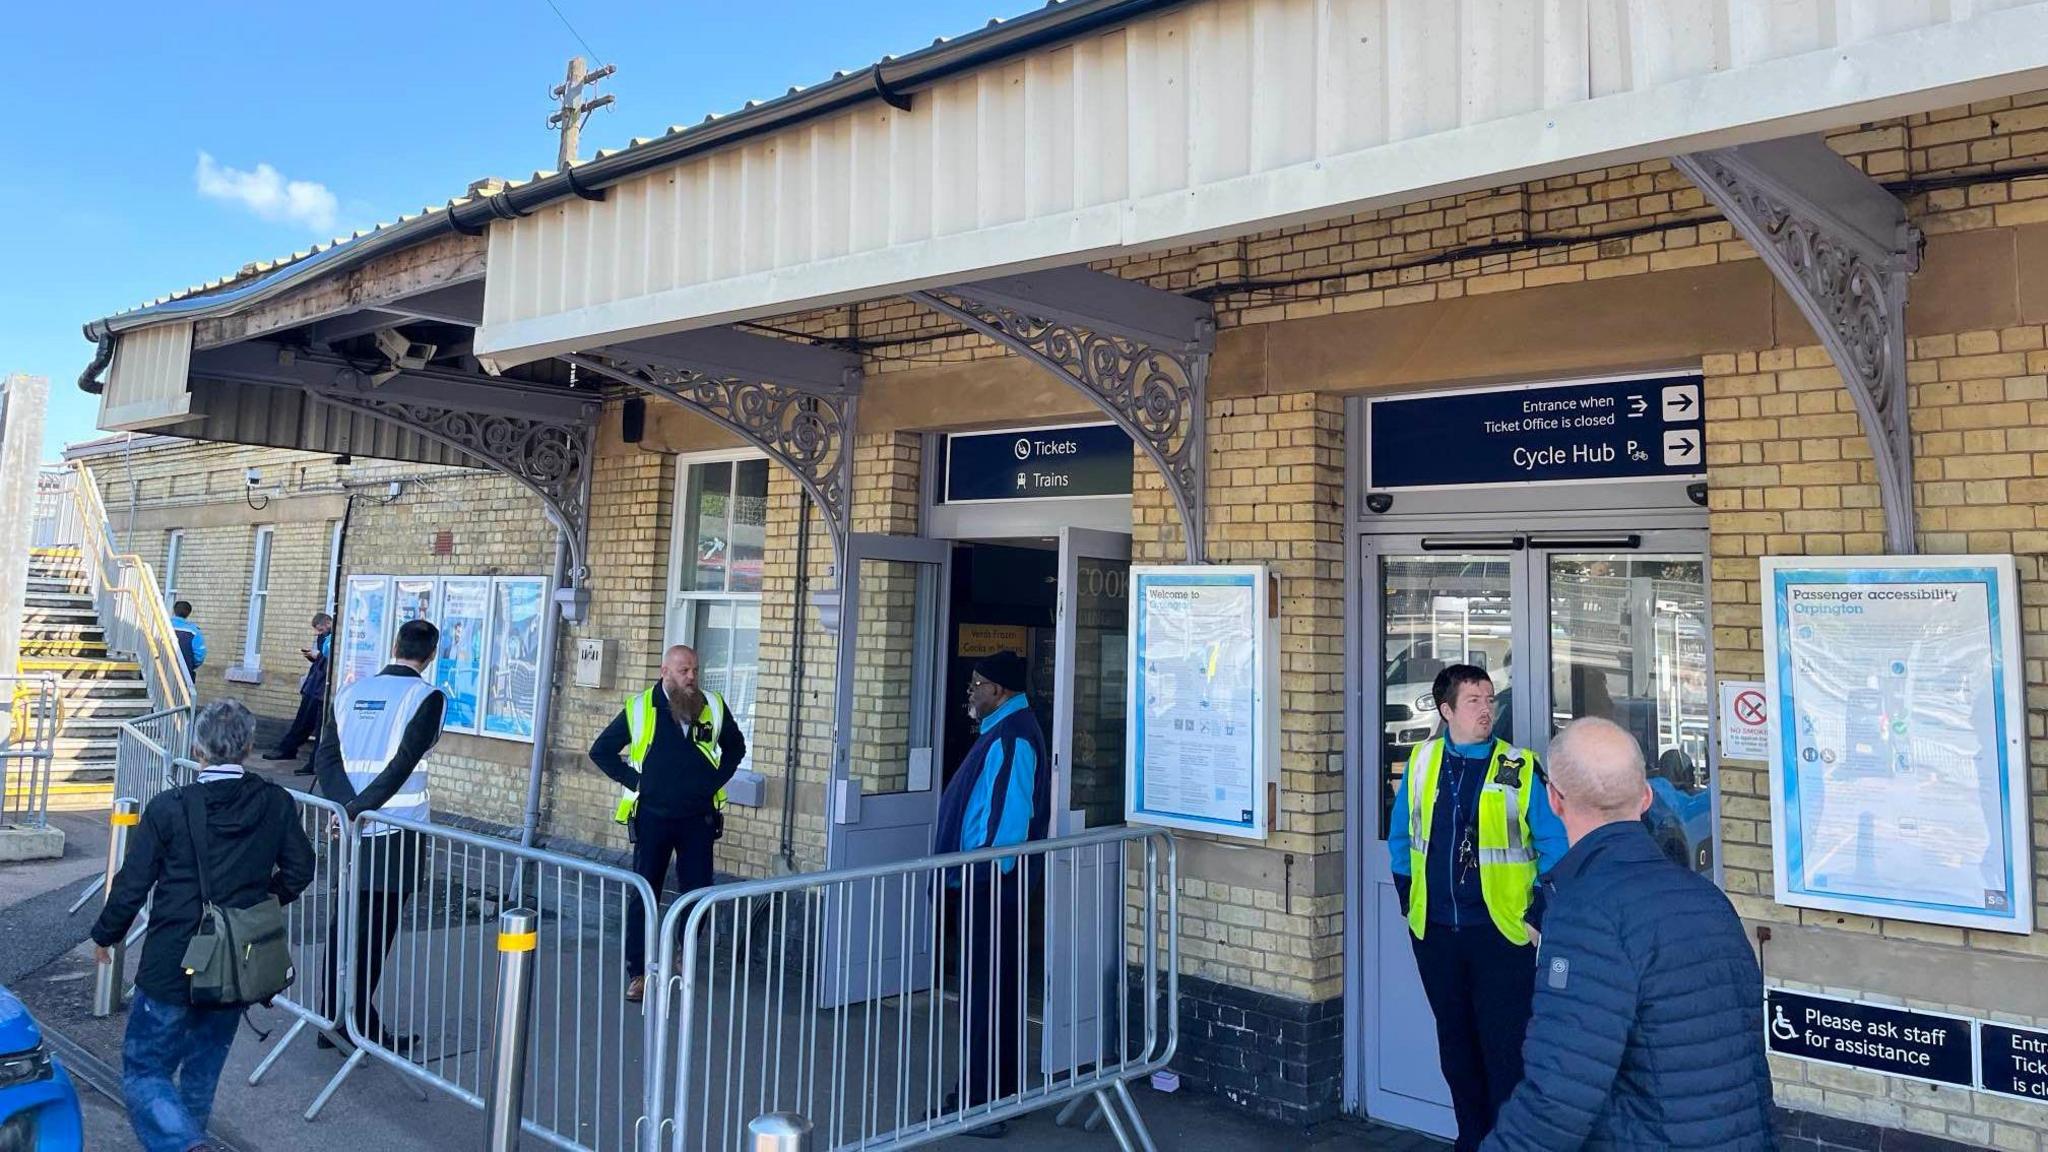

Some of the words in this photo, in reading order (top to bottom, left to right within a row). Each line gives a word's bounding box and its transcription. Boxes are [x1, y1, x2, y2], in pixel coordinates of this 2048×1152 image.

[1523, 400, 1577, 413] Entrance
[1579, 396, 1614, 409] when
[1484, 420, 1520, 433] Ticket
[1522, 417, 1558, 431] Office
[1561, 416, 1571, 428] is
[1574, 412, 1615, 428] closed
[1034, 440, 1077, 456] Tickets
[1513, 445, 1566, 470] Cycle
[1573, 442, 1615, 463] Hub
[1032, 472, 1069, 488] Trains
[1149, 589, 1188, 599] Welcome
[1191, 589, 1200, 599] to
[1792, 588, 1863, 603] Passenger
[1867, 588, 1958, 602] accessibility
[1793, 604, 1864, 616] Orpington
[1804, 1008, 1862, 1033] Please
[1867, 1021, 1899, 1039] ask
[1903, 1027, 1947, 1047] staff
[1804, 1029, 1830, 1048] for
[1834, 1037, 1931, 1066] assistance
[2011, 1034, 2048, 1056] Entr
[2013, 1076, 2027, 1093] is
[2031, 1081, 2048, 1097] cl
